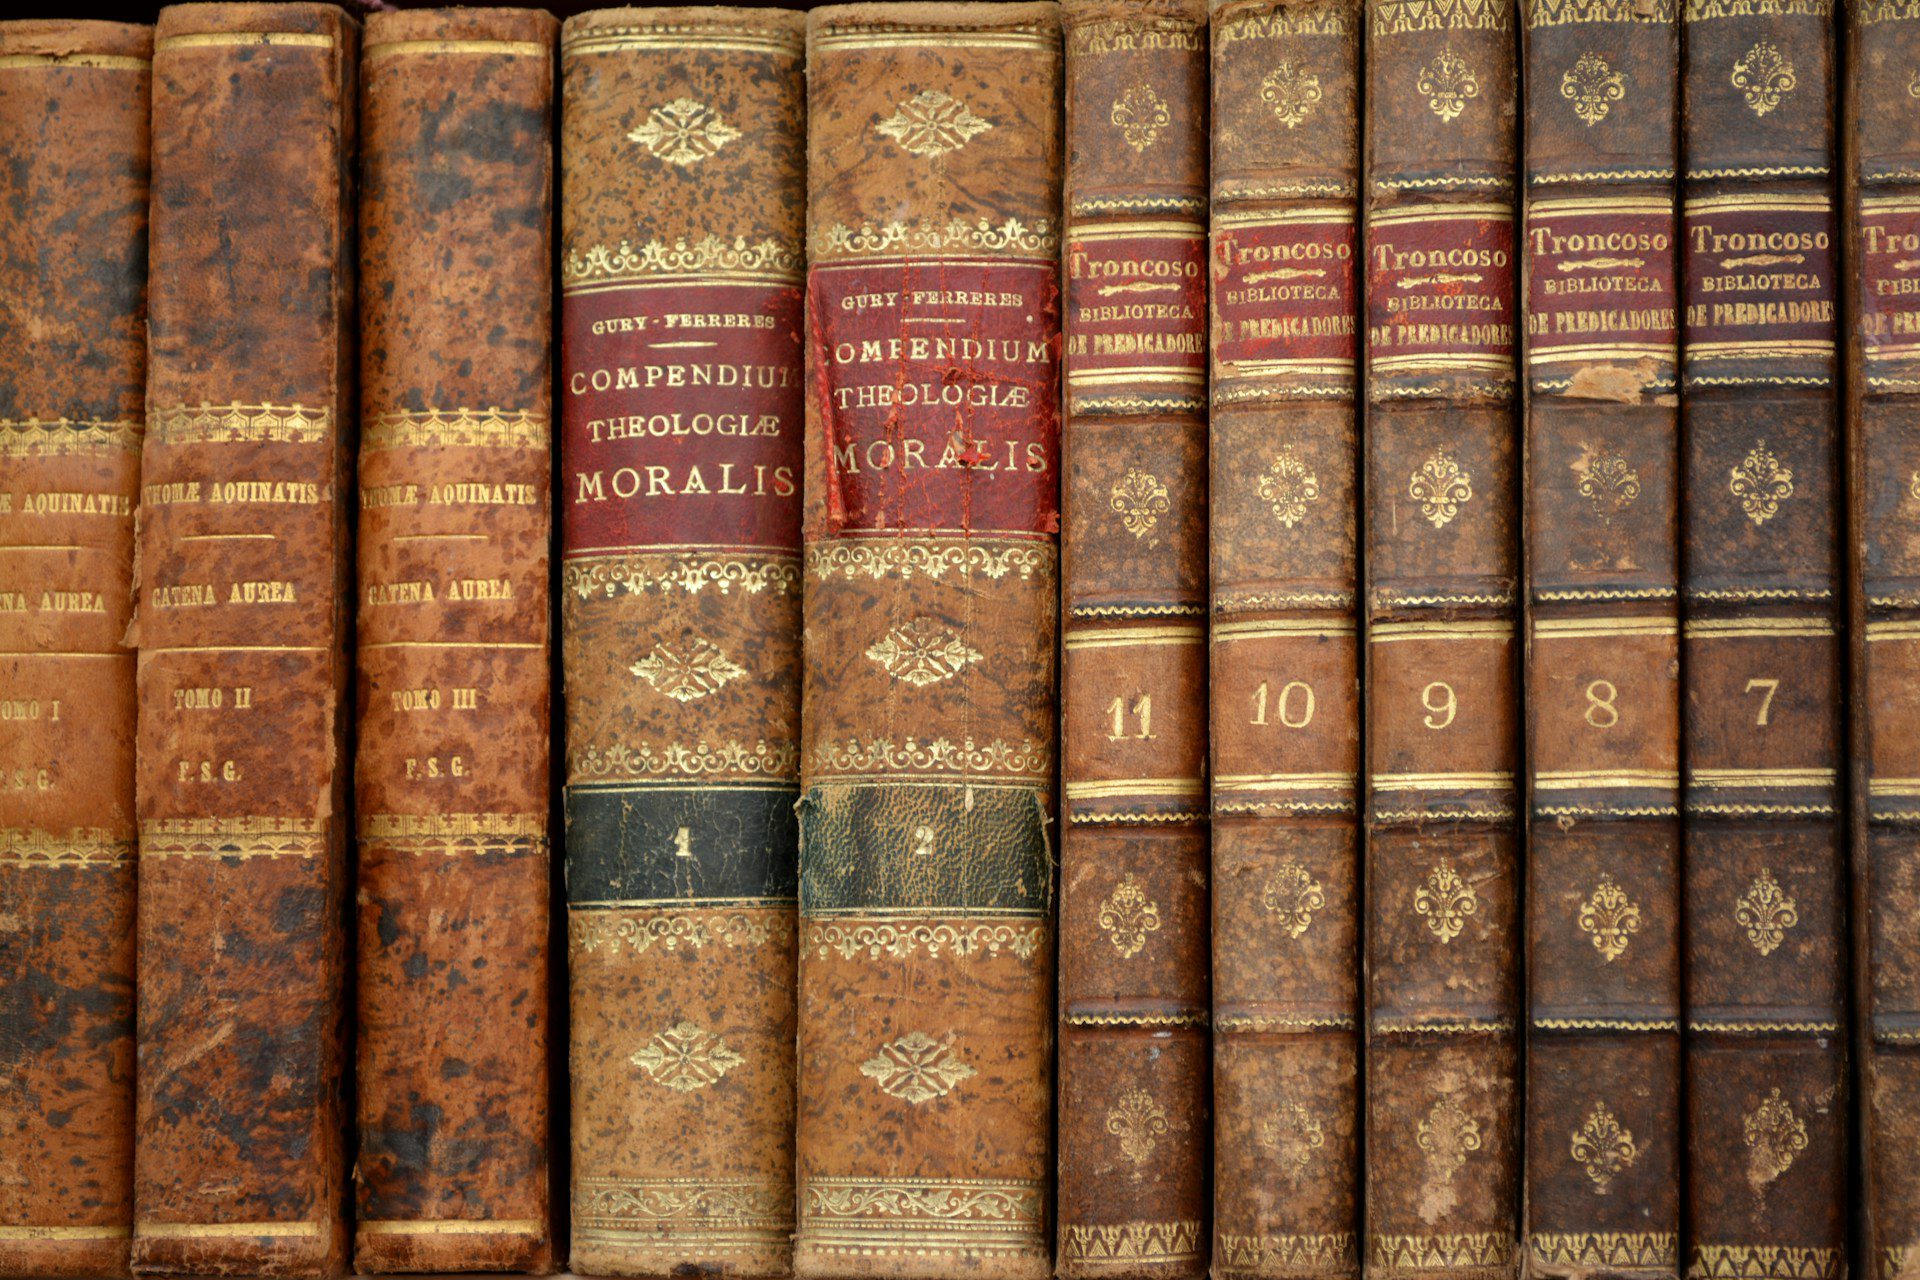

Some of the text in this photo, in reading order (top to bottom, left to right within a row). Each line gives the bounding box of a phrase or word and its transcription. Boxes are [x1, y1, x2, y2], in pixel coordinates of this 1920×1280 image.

[1217, 239, 1351, 265] Troncoso
[1531, 227, 1668, 255] Troncoso
[1691, 225, 1829, 253] Troncoso
[1070, 252, 1198, 279] Troncoso
[1373, 244, 1507, 271] Troncoso
[1226, 286, 1341, 305] BIBLIOTECA
[1544, 276, 1663, 295] BIBLIOTECA
[1702, 273, 1821, 292] BIBLIOTECA
[1080, 304, 1194, 322] BIBLIOTECA
[1387, 295, 1503, 313] BIBLIOTECA
[1686, 304, 1707, 327] DE
[592, 316, 648, 335] GURY
[664, 314, 775, 329] FERRERES
[1371, 325, 1393, 347] DE
[1529, 311, 1549, 335] DE
[834, 383, 1030, 410] THEOLOGIÆ
[586, 413, 781, 443] THEOLOGIÆ
[833, 434, 1048, 474] MORALIS
[209, 481, 319, 504] AQUINATIS
[429, 483, 537, 505] AQUINATIS
[575, 463, 795, 504] MORALIS
[22, 492, 130, 517] AQUINATIS
[41, 591, 107, 613] AUREA
[152, 581, 298, 607] CATENA AUREA
[369, 579, 516, 606] CATENA AUREA
[0, 699, 60, 721] OMO I
[174, 687, 252, 709] TOMO II
[392, 688, 477, 712] TOMO III
[1249, 680, 1316, 729] 10
[1422, 681, 1458, 730] 9
[1584, 679, 1619, 728] 8
[1744, 678, 1780, 726] 7
[1106, 693, 1157, 743] 11
[674, 826, 692, 857] 1
[915, 825, 934, 855] 2
